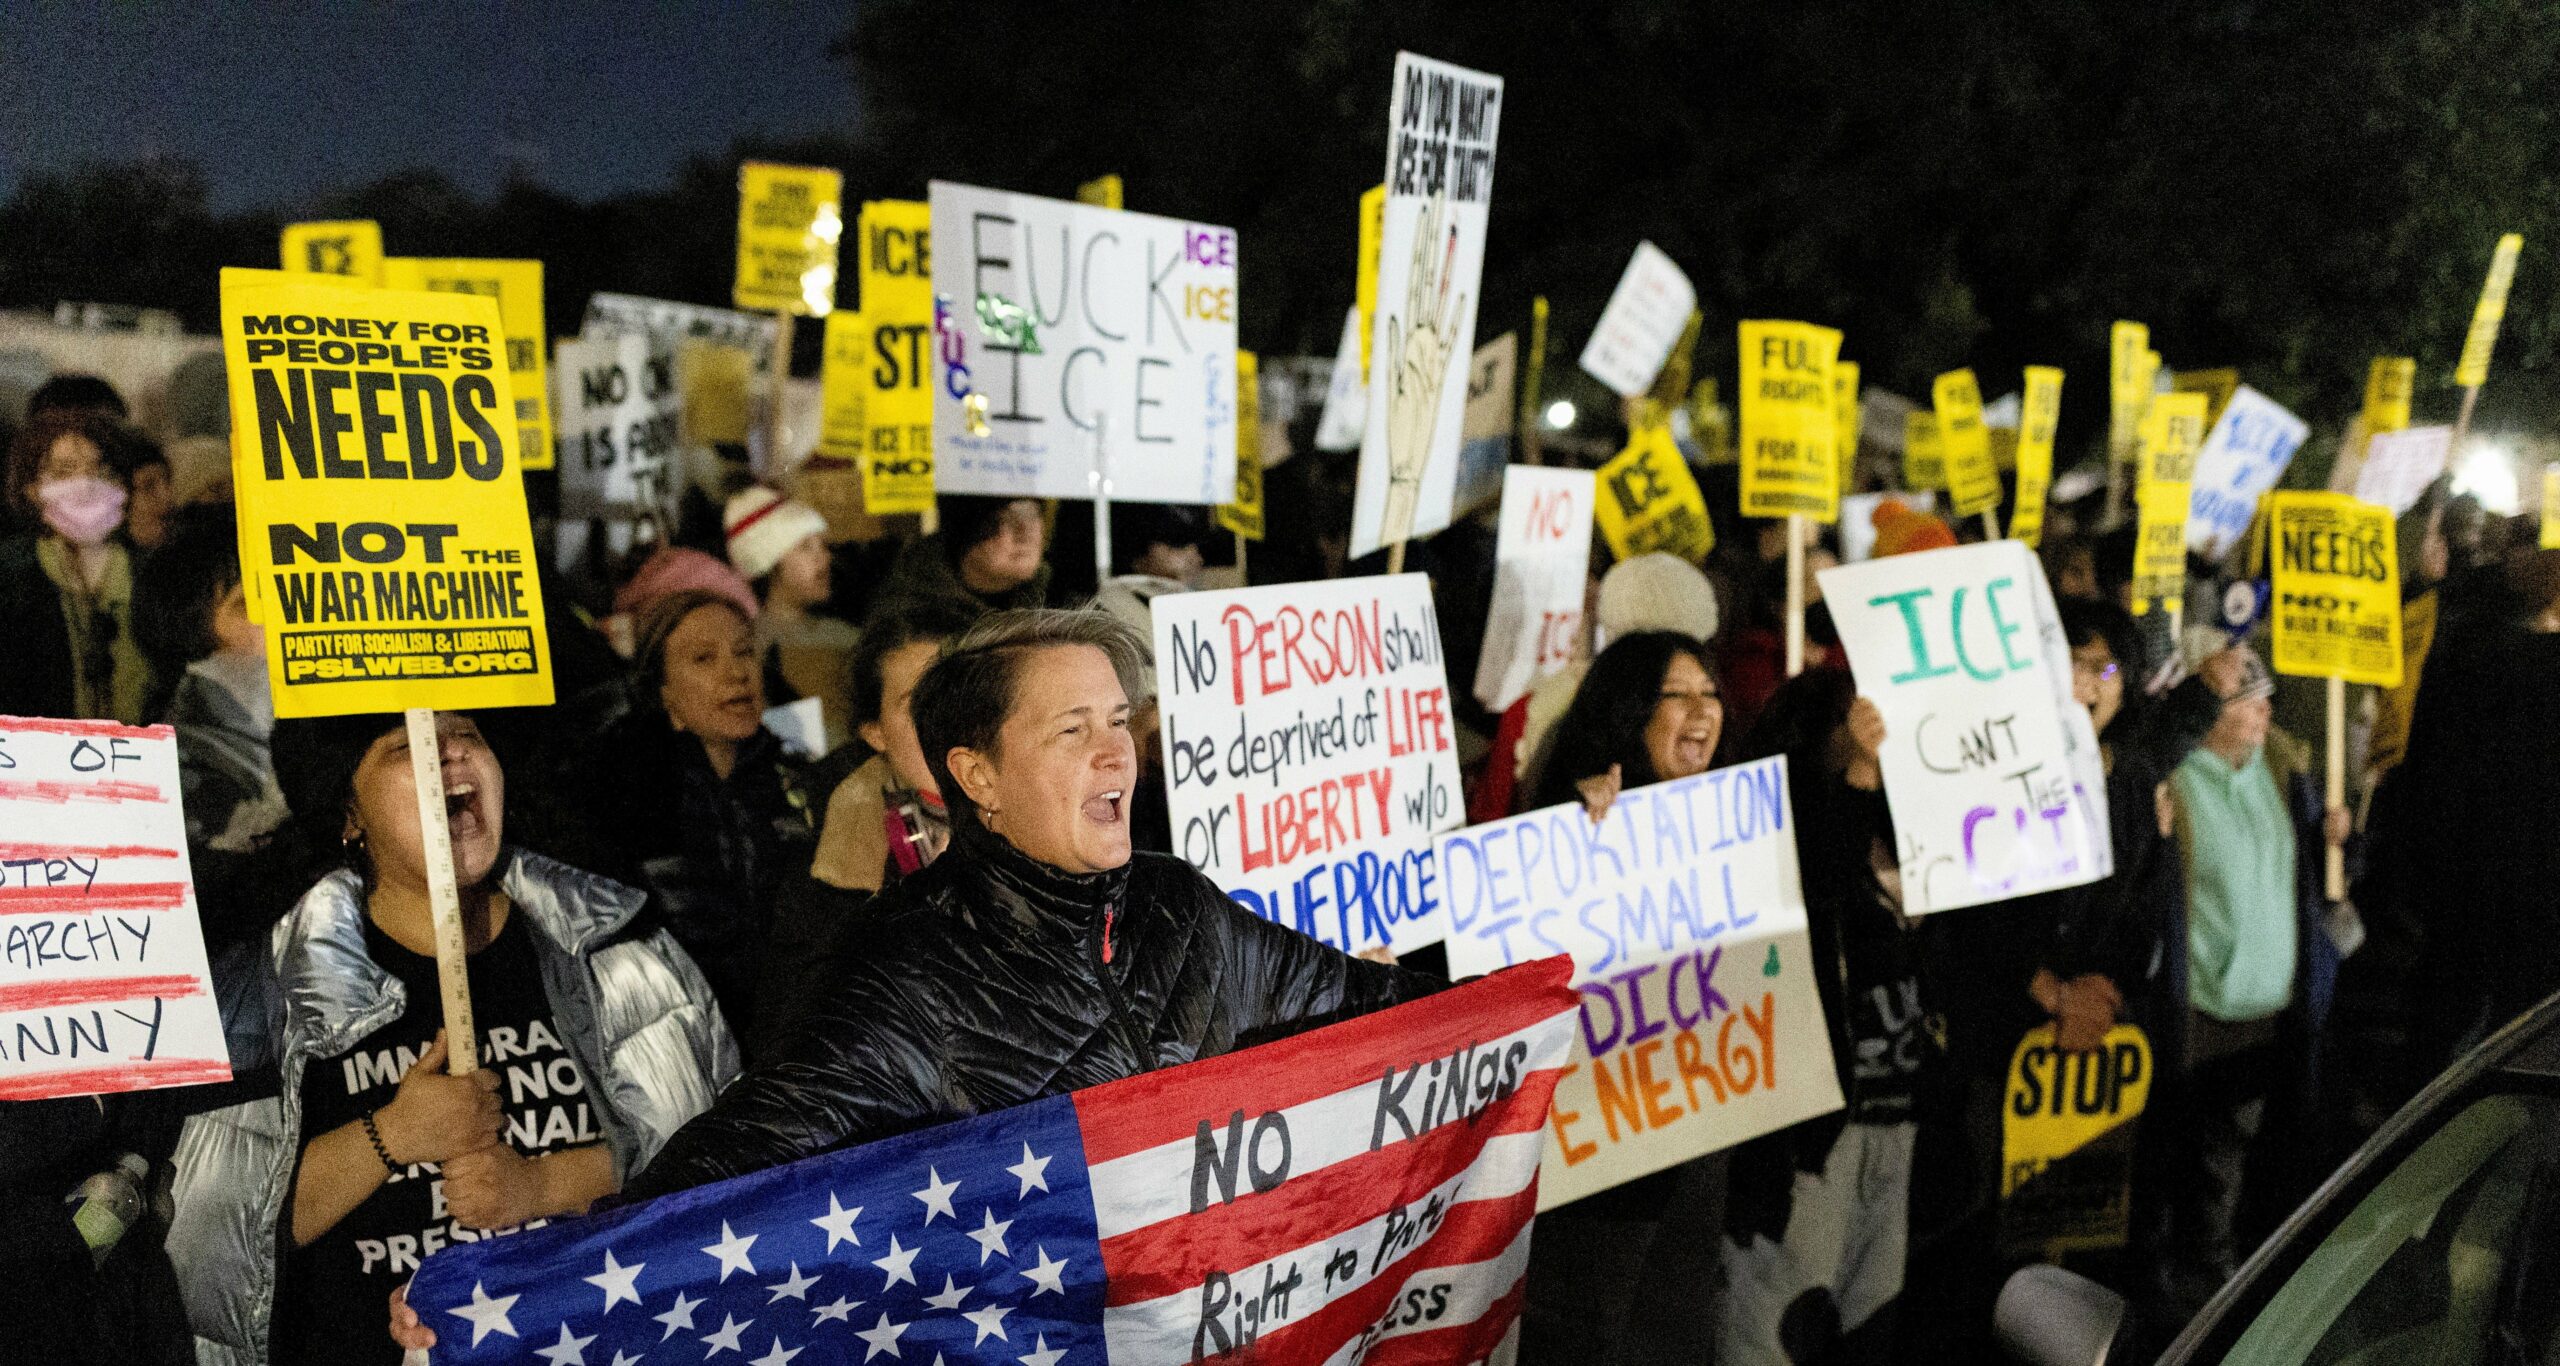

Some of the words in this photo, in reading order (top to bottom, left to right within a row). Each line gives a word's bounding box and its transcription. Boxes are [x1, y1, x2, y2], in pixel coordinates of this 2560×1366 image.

[972, 212, 1192, 354] FUCK
[1182, 228, 1234, 267] ICE
[242, 314, 398, 340] MONEY
[409, 322, 490, 344] FOR
[1182, 284, 1232, 323] ICE
[246, 338, 493, 370] PEOPLE'S
[873, 324, 929, 390] ST
[251, 367, 504, 482] NEEDS
[983, 345, 1175, 443] ICE
[872, 458, 932, 478] NO
[268, 522, 459, 565] NOT
[461, 549, 522, 564] THE
[2281, 530, 2387, 583] NEEDS
[273, 571, 369, 624] WAR
[372, 570, 529, 622] MACHINE
[1867, 576, 2034, 686] ICE
[285, 632, 332, 658] PARTY
[335, 633, 363, 656] FOR
[364, 632, 432, 655] SOCIALISM
[435, 633, 453, 654] &
[454, 629, 530, 653] LIBERATION
[287, 651, 533, 681] PSLWEB.ORG
[1171, 618, 1218, 695] No
[1221, 598, 1385, 706] PERSON
[1384, 604, 1442, 673] shall
[70, 737, 142, 773] OF
[1170, 713, 1218, 790] be
[1227, 697, 1347, 787] deprived
[1352, 687, 1378, 748] of
[1384, 686, 1449, 758] LIFE
[1183, 803, 1231, 871] or
[1235, 766, 1393, 874] LIBERTY
[1403, 762, 1448, 832] w/o
[1443, 760, 1784, 935] DEPORTATION
[0, 914, 151, 969] ARCHY
[1577, 863, 1759, 974] SMALL
[1577, 945, 1729, 1058] DICK
[1551, 992, 1777, 1167] ENERGY
[2013, 1042, 2143, 1118] STOP
[1189, 1108, 1293, 1215] NO
[1191, 1260, 1303, 1366] Right
[1323, 1246, 1360, 1294] to
